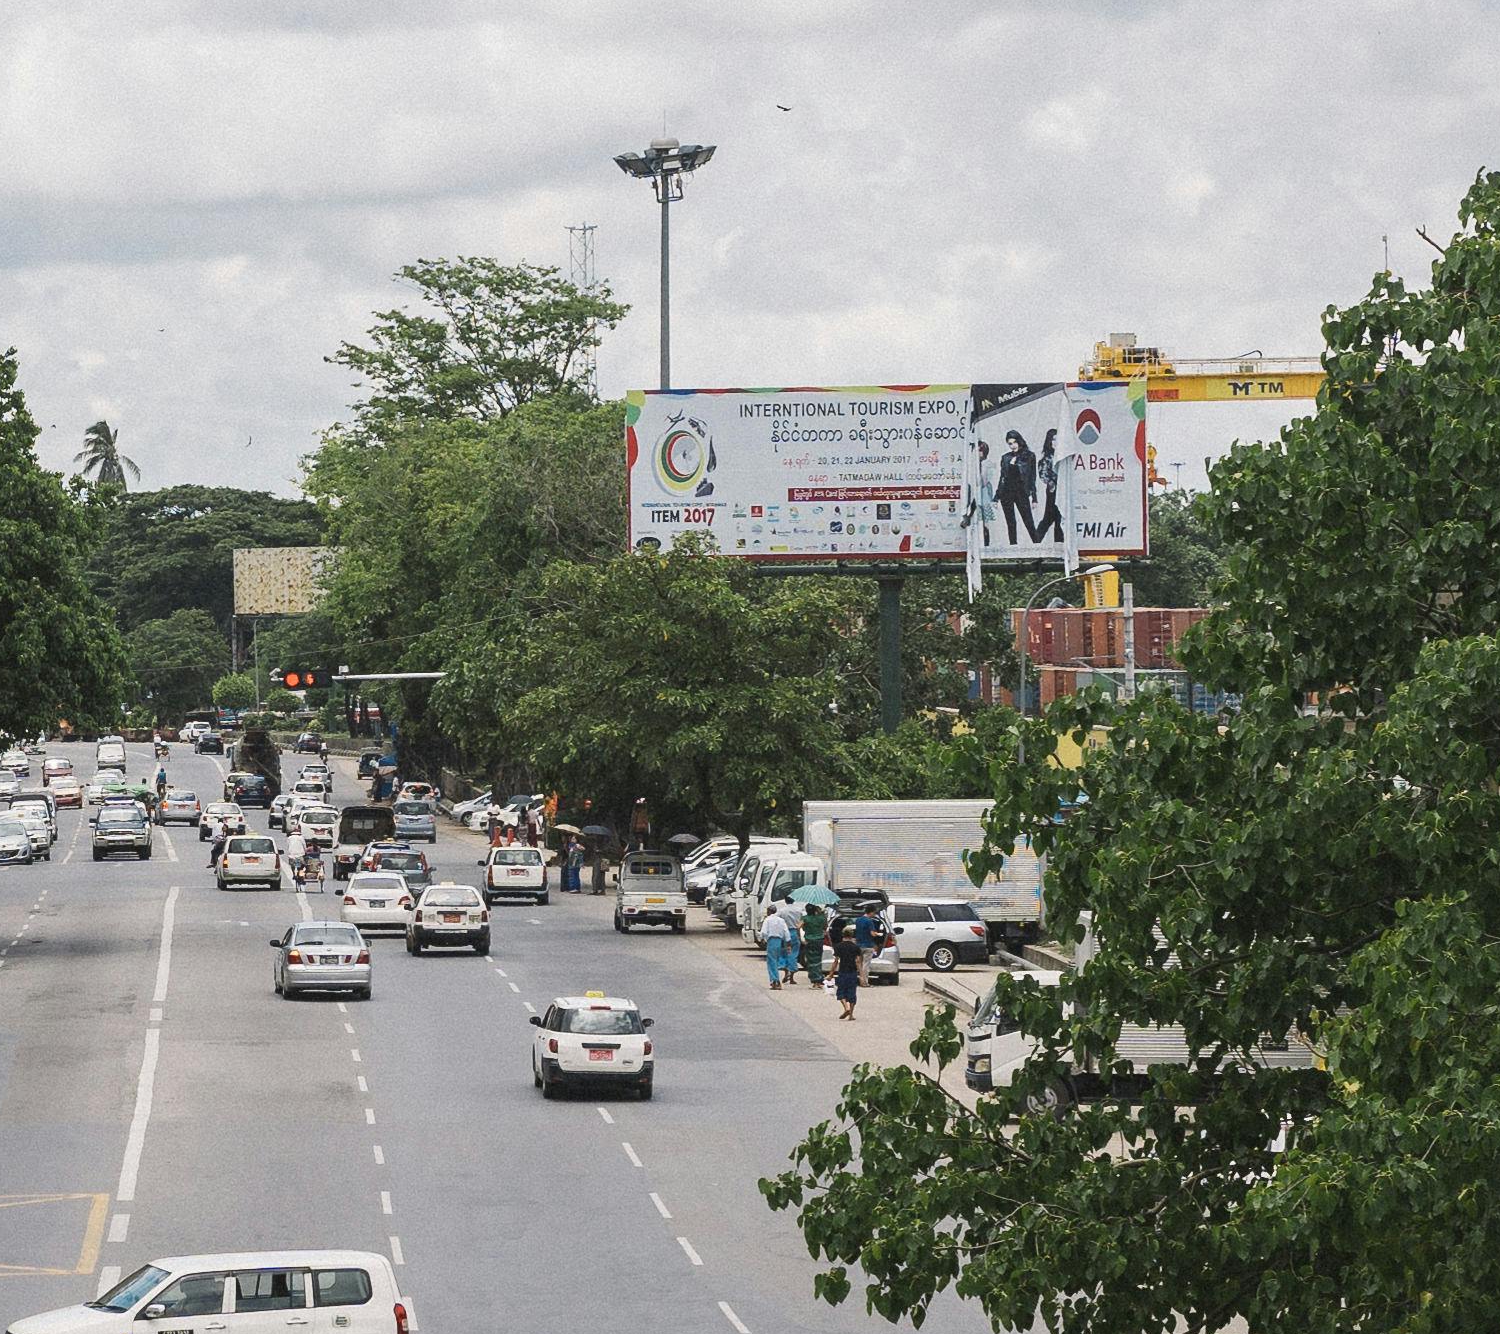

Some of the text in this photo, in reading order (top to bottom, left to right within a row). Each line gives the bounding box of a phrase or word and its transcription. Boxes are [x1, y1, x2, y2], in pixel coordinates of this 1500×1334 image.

[739, 400, 960, 418] INTERNTIONAL TOURISM EXPO,
[855, 456, 892, 465] JANUARY
[893, 455, 911, 465] 2017
[1090, 452, 1125, 471] Bank
[884, 473, 904, 482] HALL
[651, 508, 715, 526] ITEM 2017
[1104, 521, 1127, 538] Air
